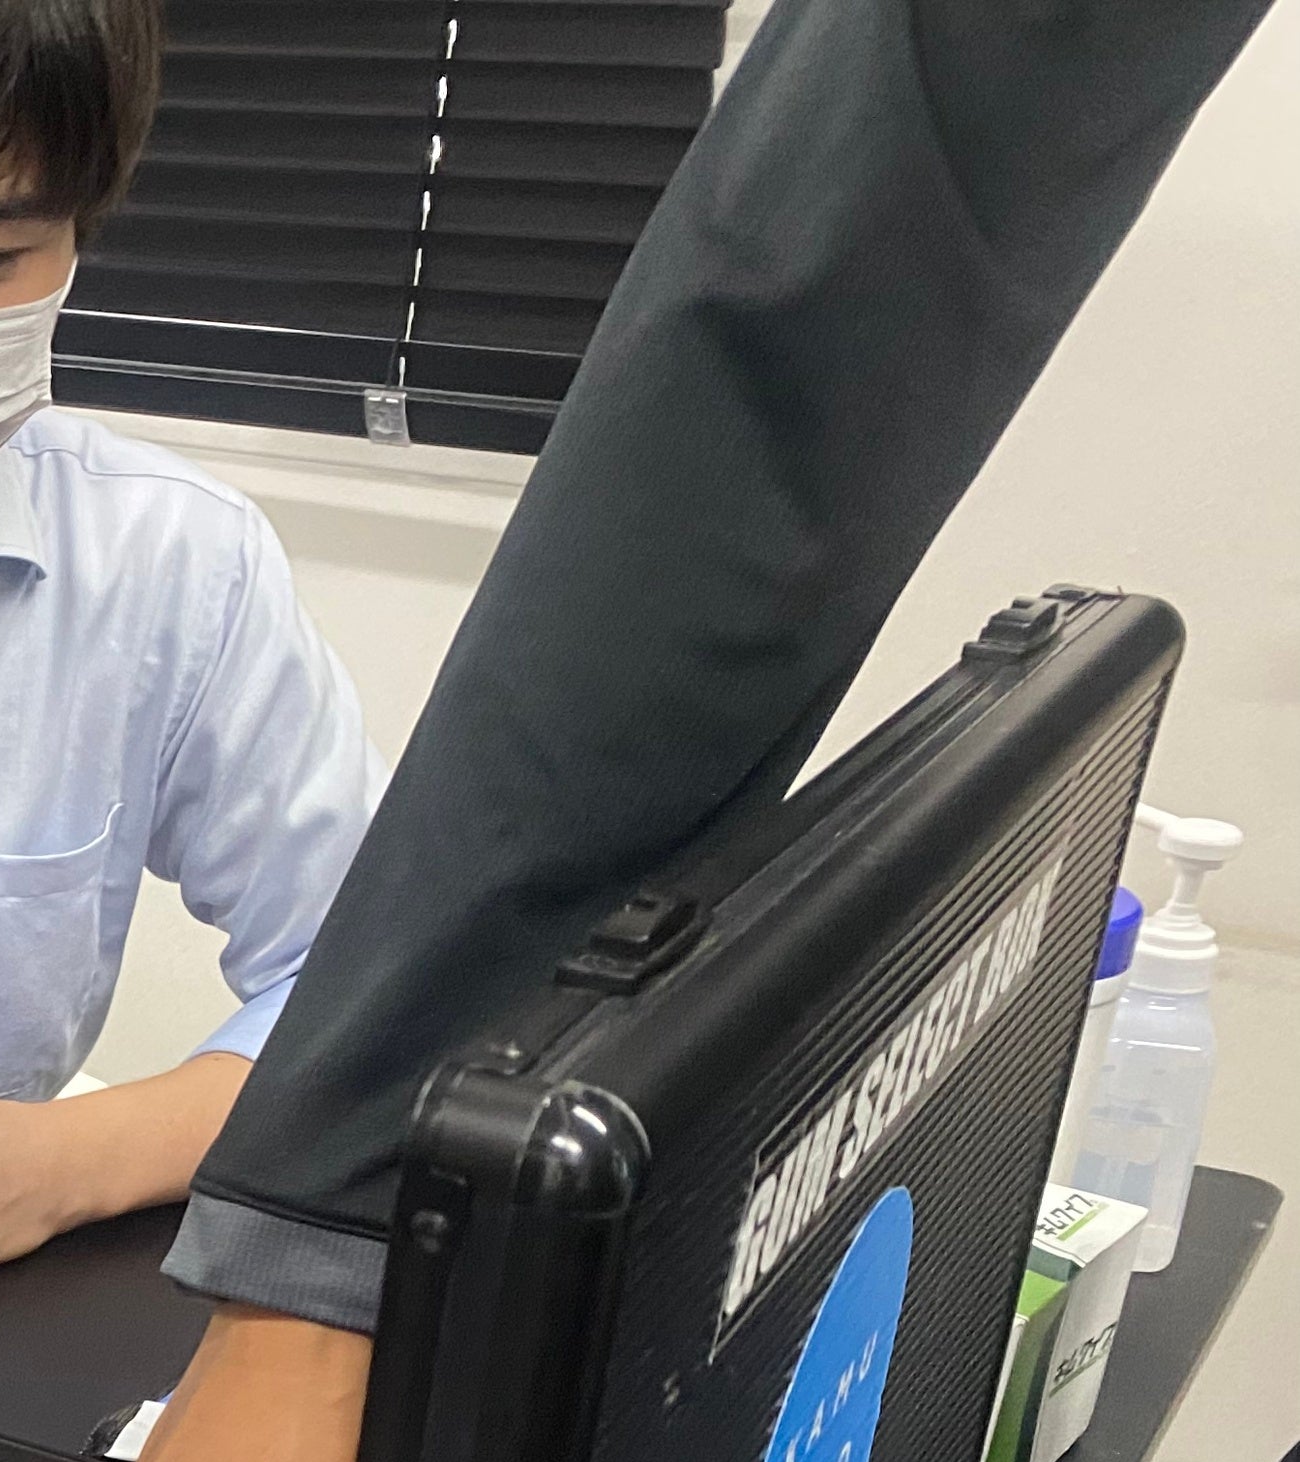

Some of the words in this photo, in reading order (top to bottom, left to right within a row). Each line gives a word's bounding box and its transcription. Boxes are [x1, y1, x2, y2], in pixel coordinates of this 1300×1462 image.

[725, 1089, 852, 1317] GUM
[839, 931, 994, 1178] SELECT
[974, 857, 1062, 1024] BOX
